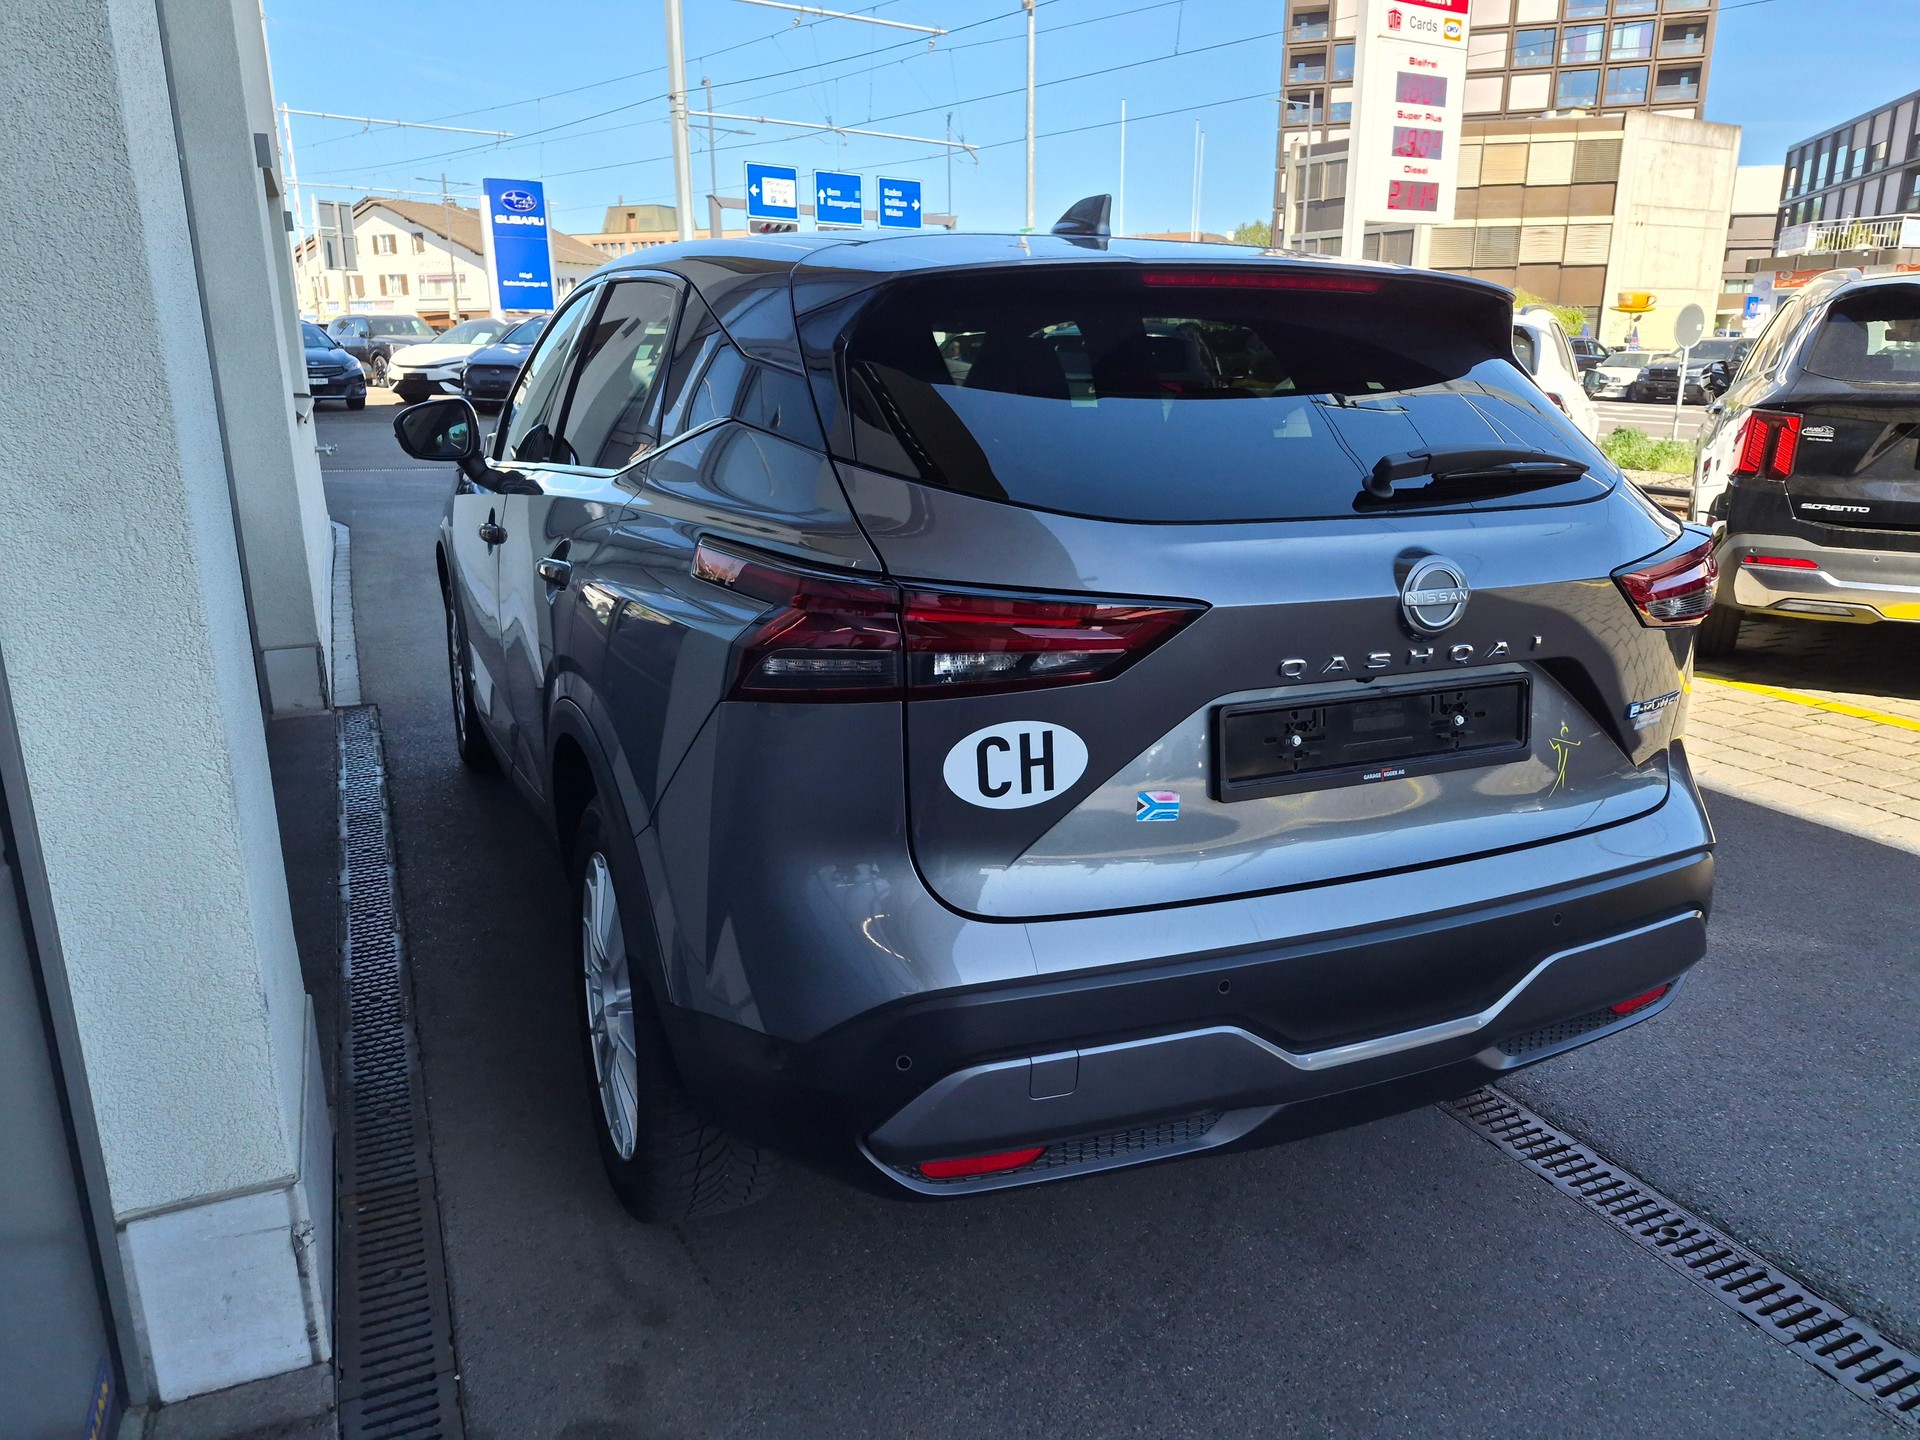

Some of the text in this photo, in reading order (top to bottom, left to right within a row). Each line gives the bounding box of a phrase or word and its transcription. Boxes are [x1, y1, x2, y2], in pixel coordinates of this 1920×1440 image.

[1409, 16, 1438, 32] Cards
[1409, 57, 1438, 68] Bleifrei
[1397, 110, 1442, 122] Super Plus
[1403, 165, 1428, 174] Diesel
[494, 214, 544, 226] SUBARU
[1800, 502, 1870, 514] SORENTO
[1408, 590, 1468, 603] NISSAN
[1280, 635, 1543, 679] QASHQAI
[976, 730, 1054, 798] CH
[1363, 772, 1381, 780] GARAGE
